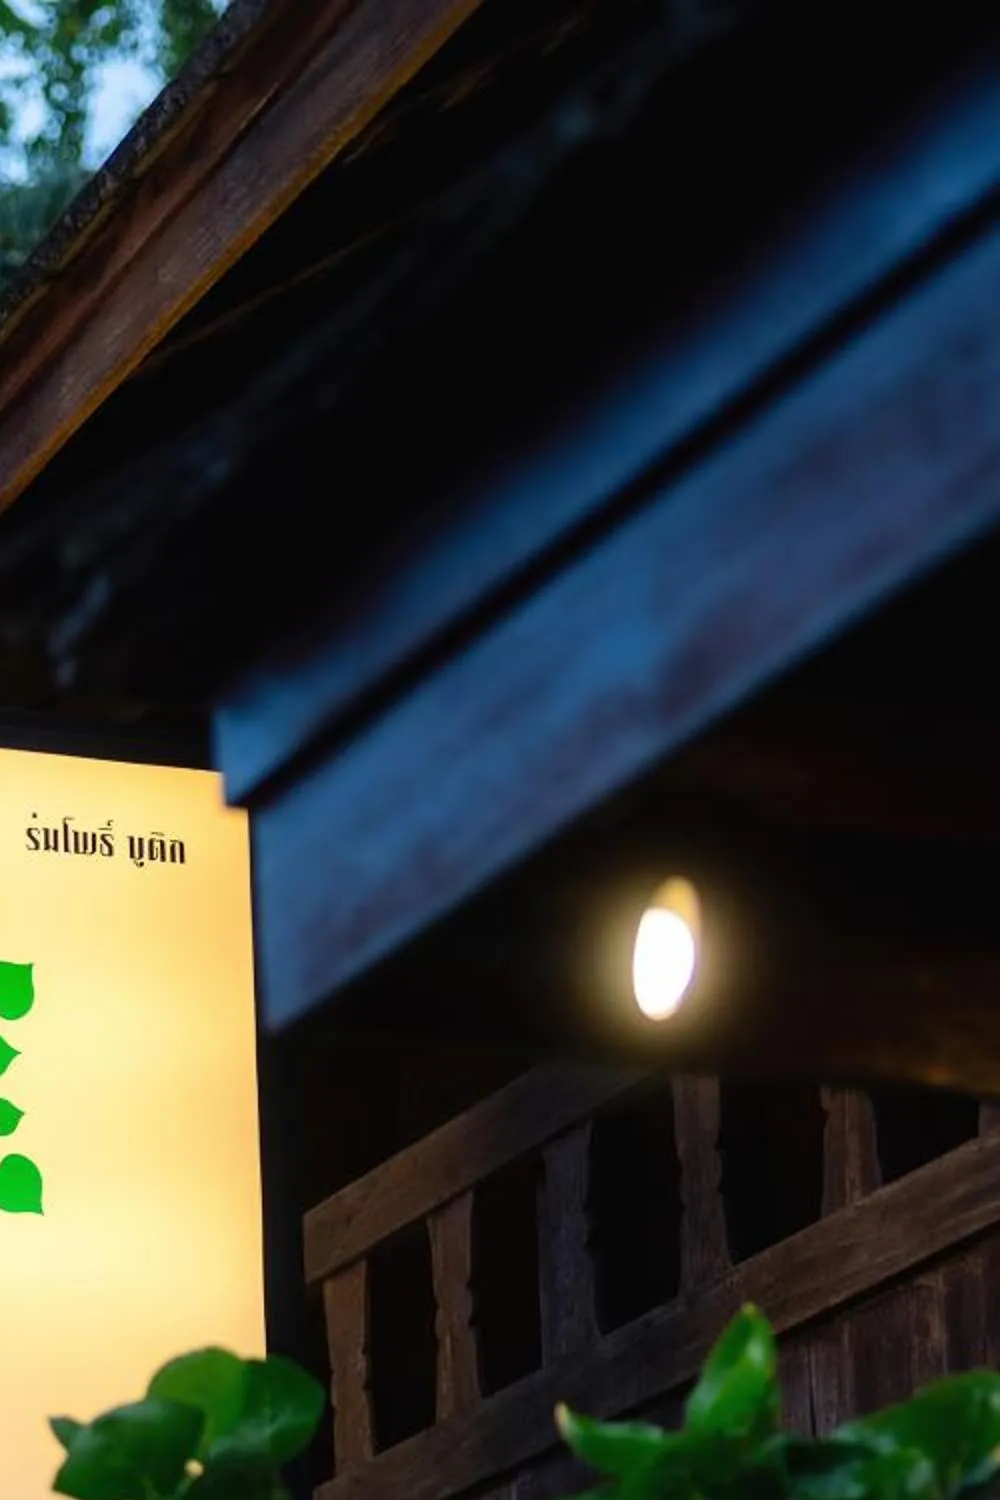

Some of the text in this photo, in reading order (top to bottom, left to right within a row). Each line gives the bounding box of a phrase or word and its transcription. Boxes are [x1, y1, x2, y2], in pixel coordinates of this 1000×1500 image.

[26, 812, 187, 868] ร่มโพธิ์ บูติก
